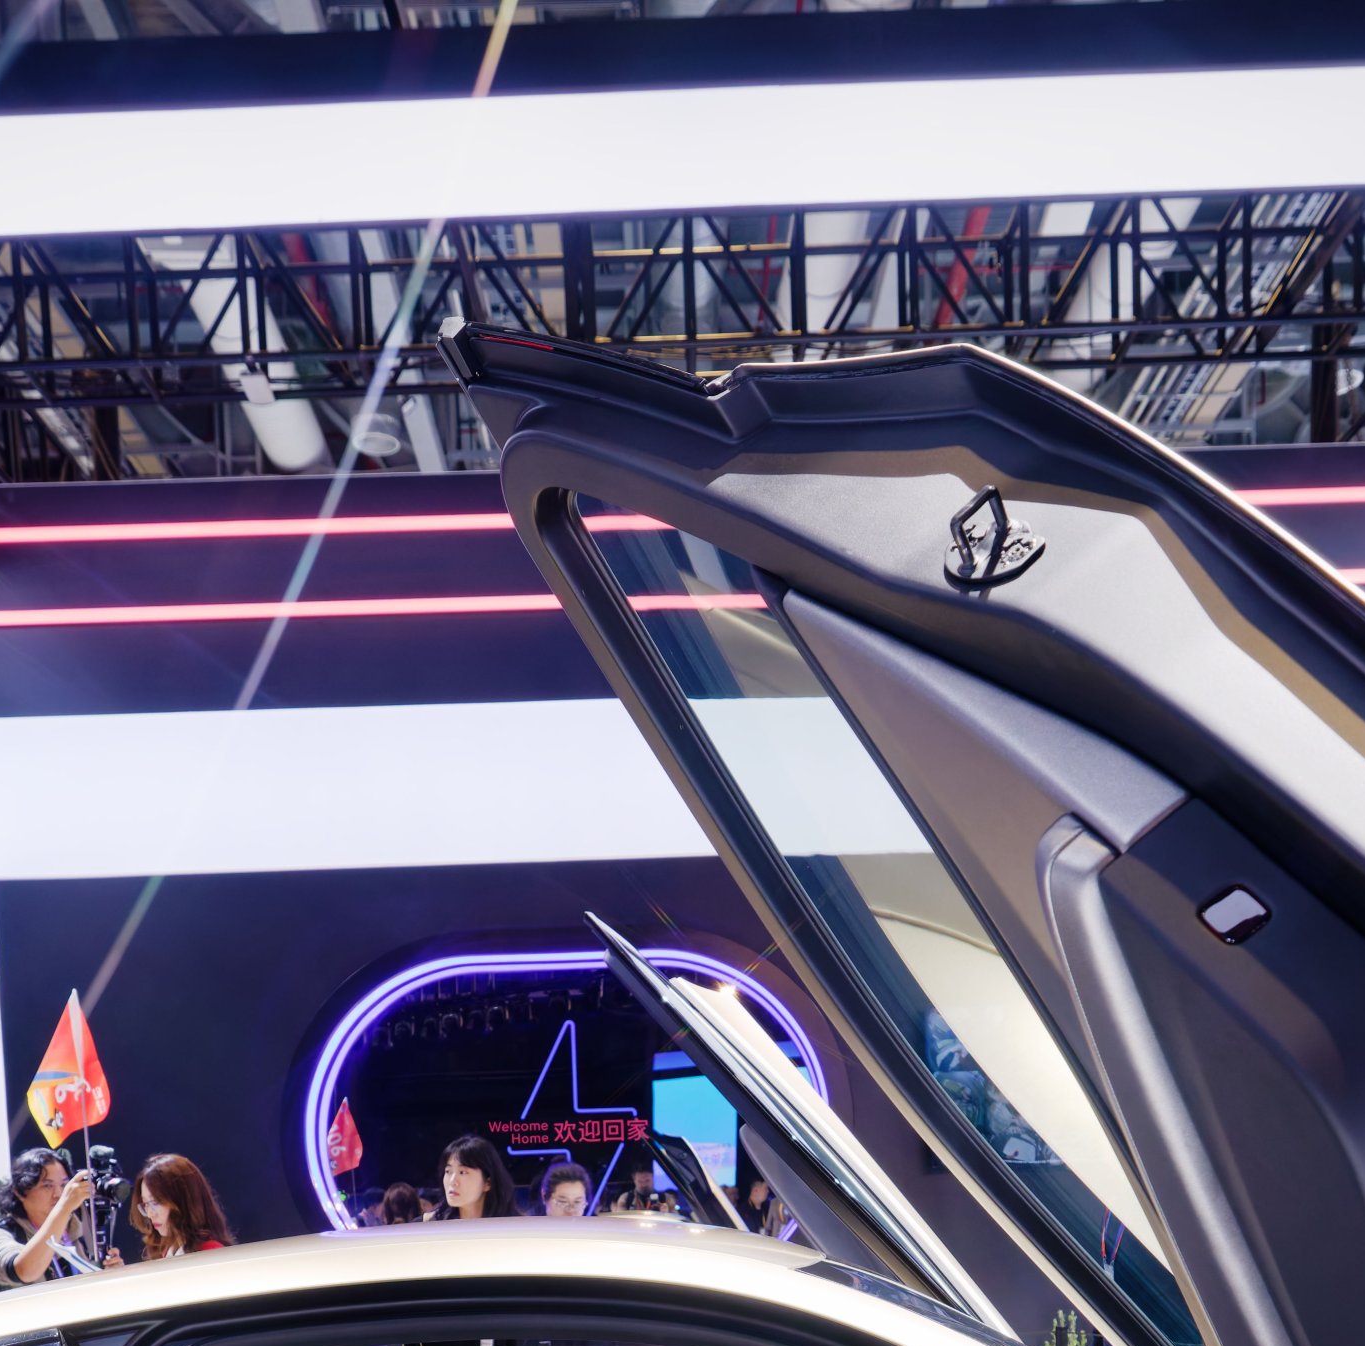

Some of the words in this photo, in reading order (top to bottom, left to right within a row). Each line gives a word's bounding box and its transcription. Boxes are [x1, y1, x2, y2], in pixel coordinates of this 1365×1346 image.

[489, 1121, 549, 1132] Welcome
[553, 1118, 651, 1143] 欢迎回家
[511, 1134, 549, 1144] Home
